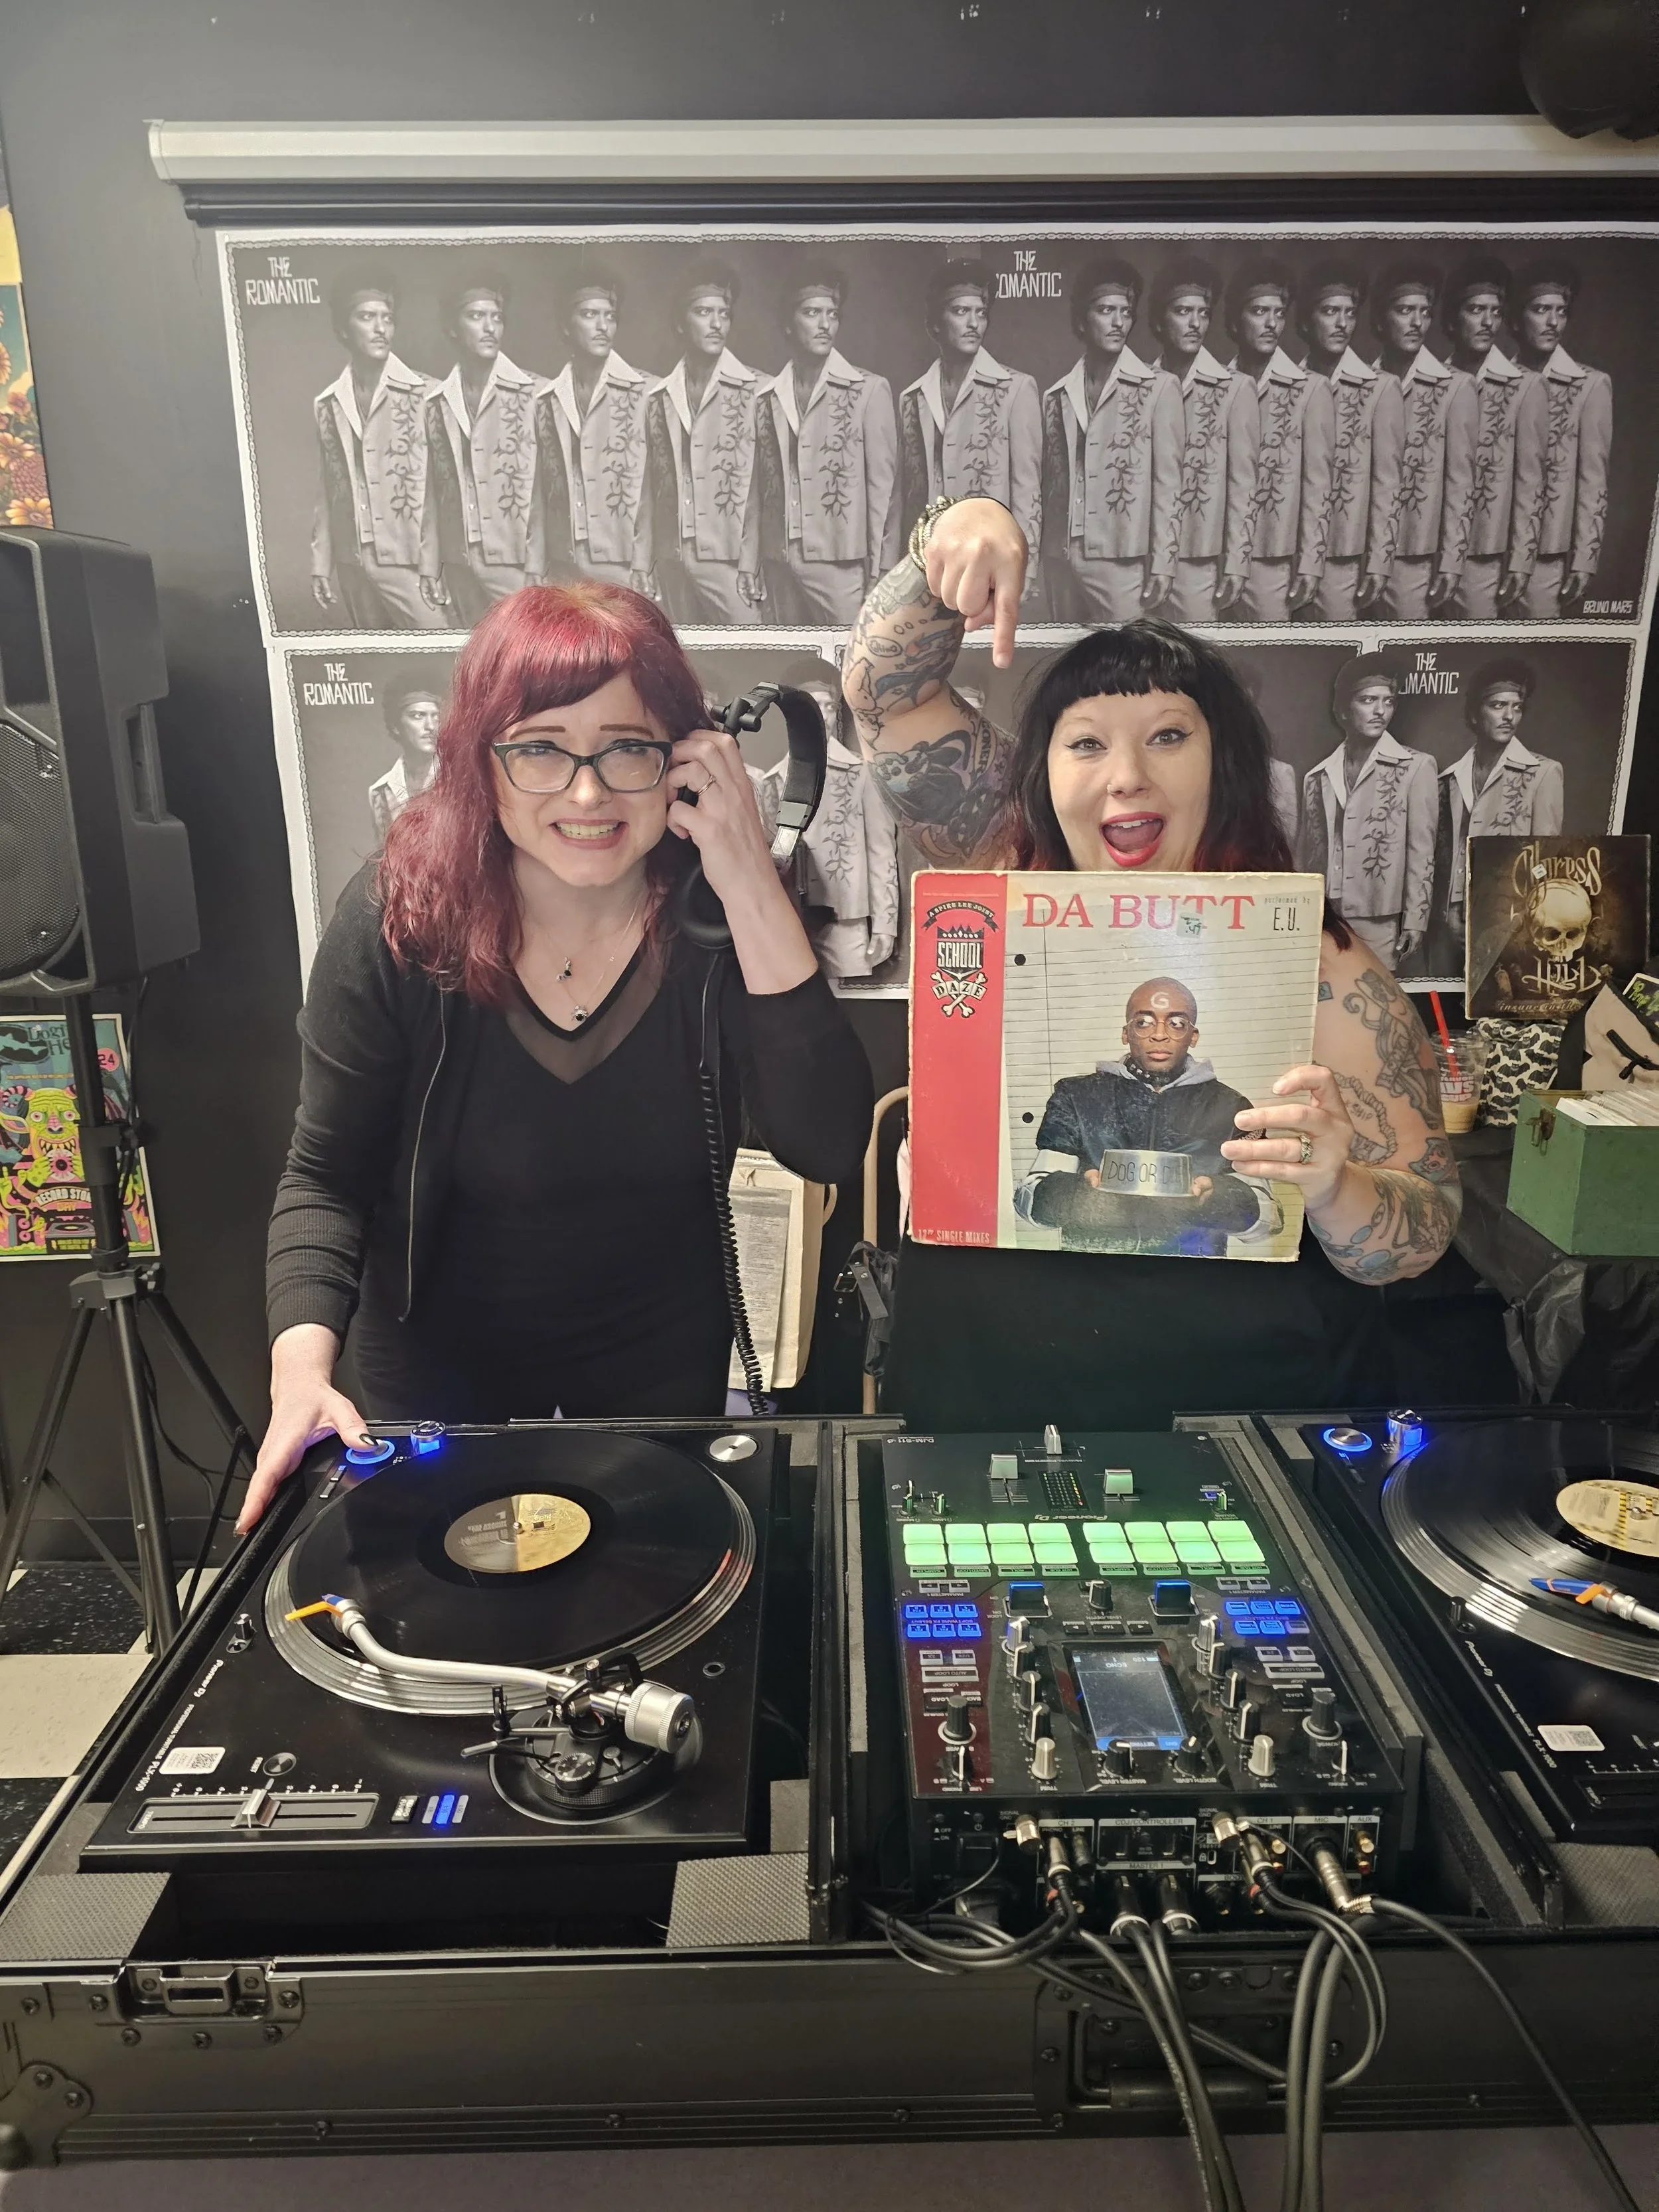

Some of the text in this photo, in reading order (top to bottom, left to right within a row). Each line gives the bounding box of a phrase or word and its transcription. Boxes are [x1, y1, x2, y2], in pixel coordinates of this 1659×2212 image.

[267, 257, 292, 277] THE
[1014, 250, 1037, 271] THE
[246, 278, 321, 305] ROMANTIC
[995, 272, 1062, 299] OMANTIC
[1583, 600, 1633, 614] BRUNO MARS
[324, 663, 348, 682] THE
[1415, 652, 1437, 671] THE
[303, 682, 374, 705] ROMANTIC
[1398, 672, 1459, 695] MANTIC
[934, 902, 957, 914] SPIKE
[973, 905, 994, 917] JOINT
[1022, 893, 1256, 930] DA BUTT
[1273, 907, 1301, 931] E.U.
[938, 942, 983, 968] SCHOOL
[935, 982, 983, 997] DAZE
[1150, 992, 1169, 1009] G
[1108, 1161, 1135, 1182] DOG
[1139, 1163, 1157, 1183] OR
[936, 1230, 964, 1243] SINGLE
[966, 1231, 990, 1244] MIXES
[201, 1659, 224, 1688] Pioneer
[135, 1761, 160, 1791] PLX-1000
